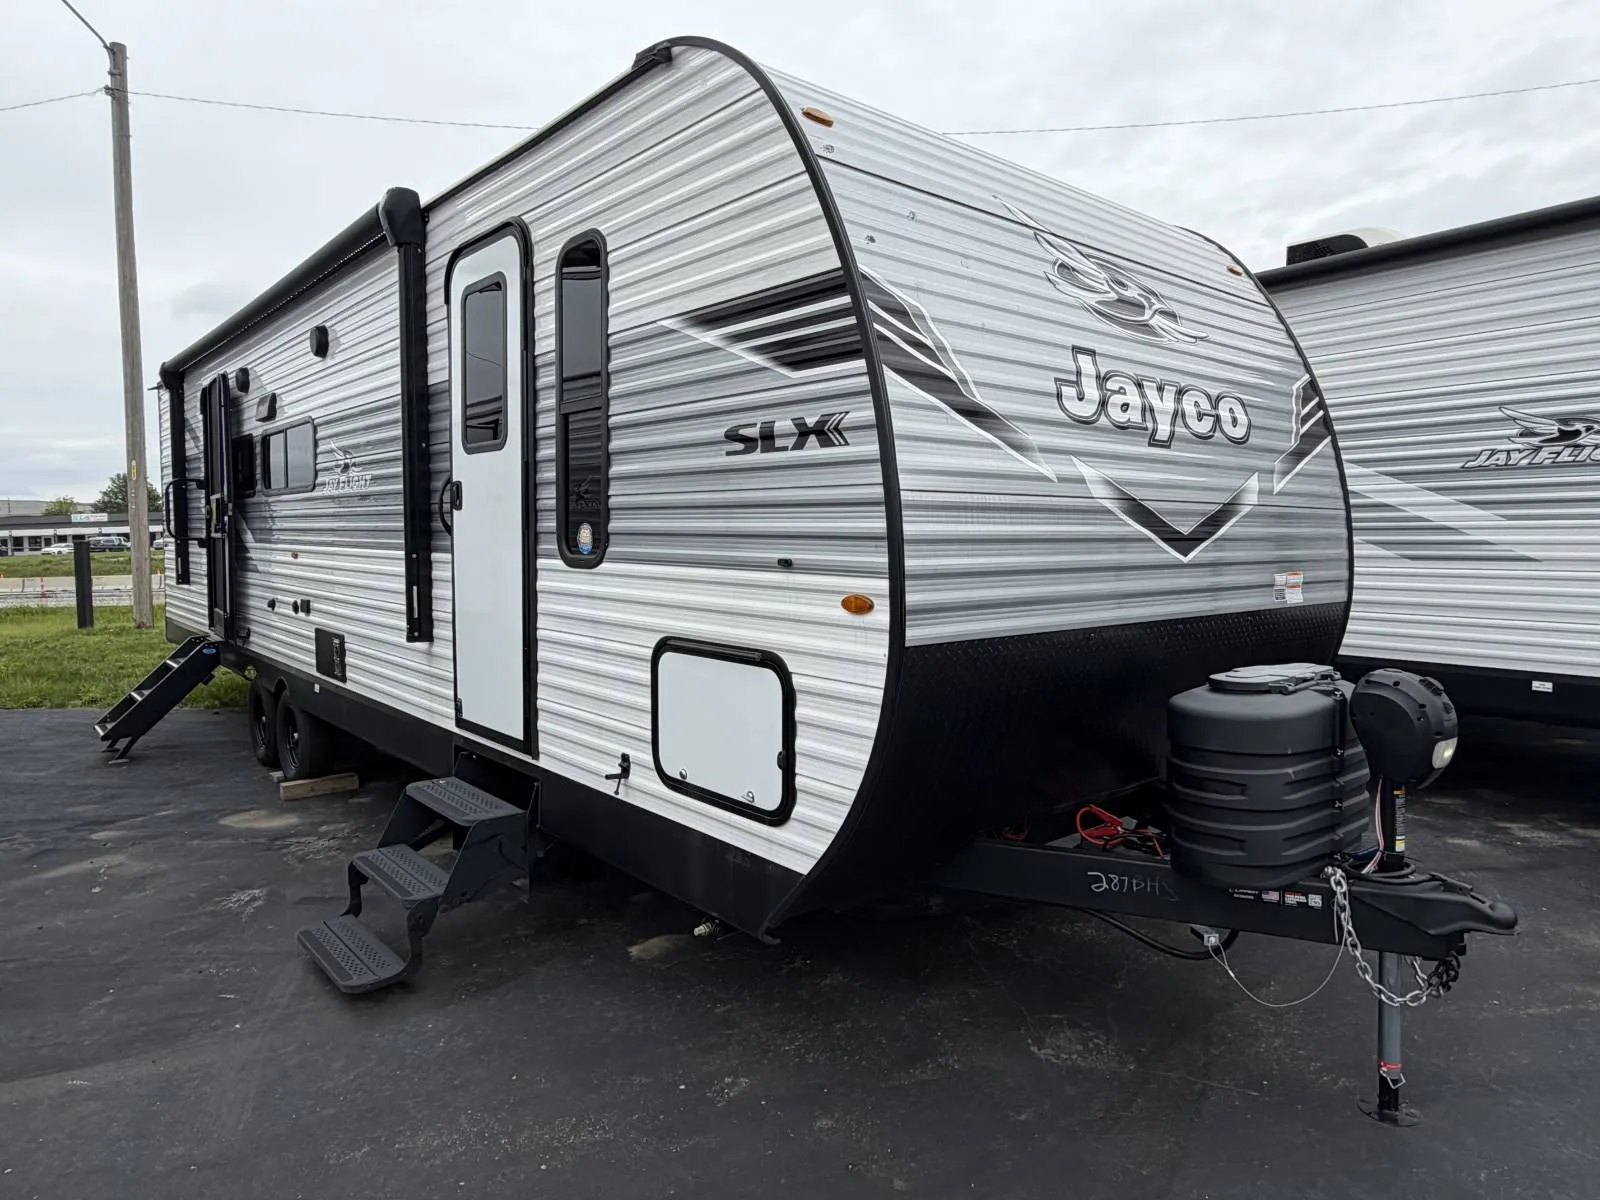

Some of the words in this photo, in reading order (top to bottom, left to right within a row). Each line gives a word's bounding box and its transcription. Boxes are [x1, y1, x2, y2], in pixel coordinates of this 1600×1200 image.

[1054, 344, 1252, 449] Jayco
[723, 411, 851, 457] SLX
[1460, 447, 1541, 470] JAY
